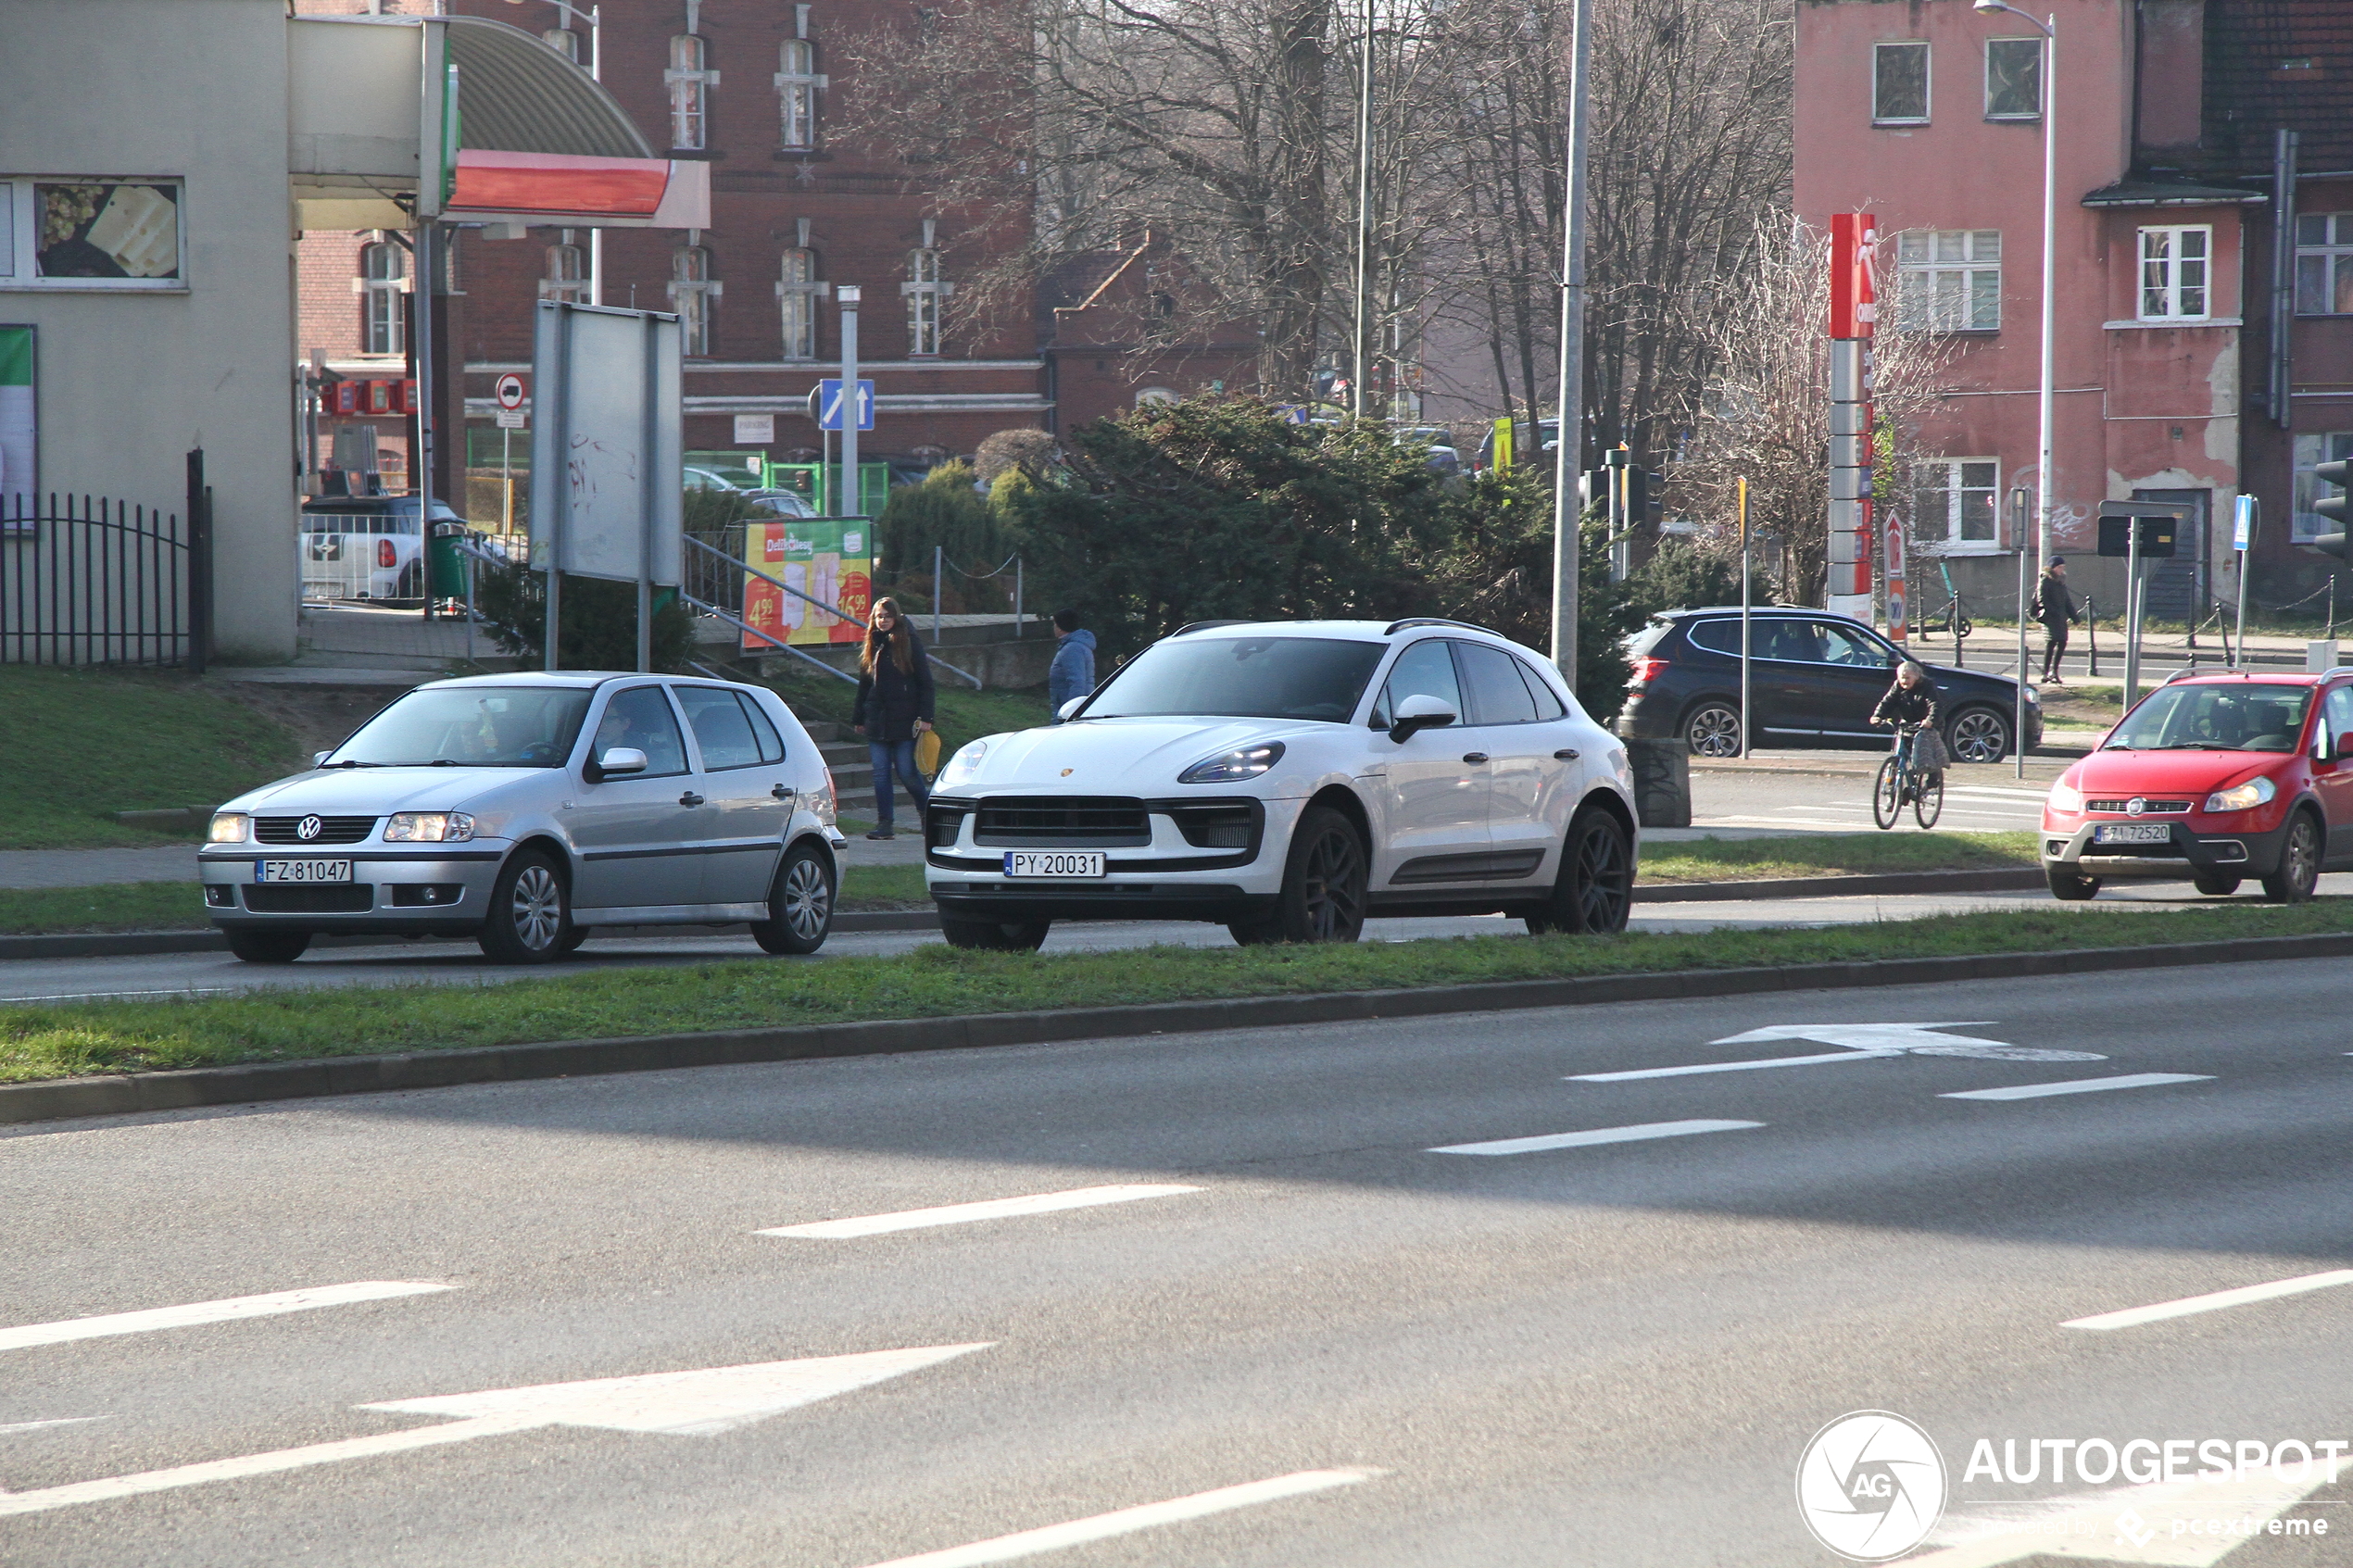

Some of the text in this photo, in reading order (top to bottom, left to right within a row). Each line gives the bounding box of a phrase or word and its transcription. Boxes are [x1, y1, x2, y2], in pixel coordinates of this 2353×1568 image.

[2130, 826, 2168, 840] 72520
[266, 861, 289, 880] FZ
[296, 861, 347, 880] 81047
[1015, 855, 1037, 873] PY
[1044, 855, 1097, 874] 20031
